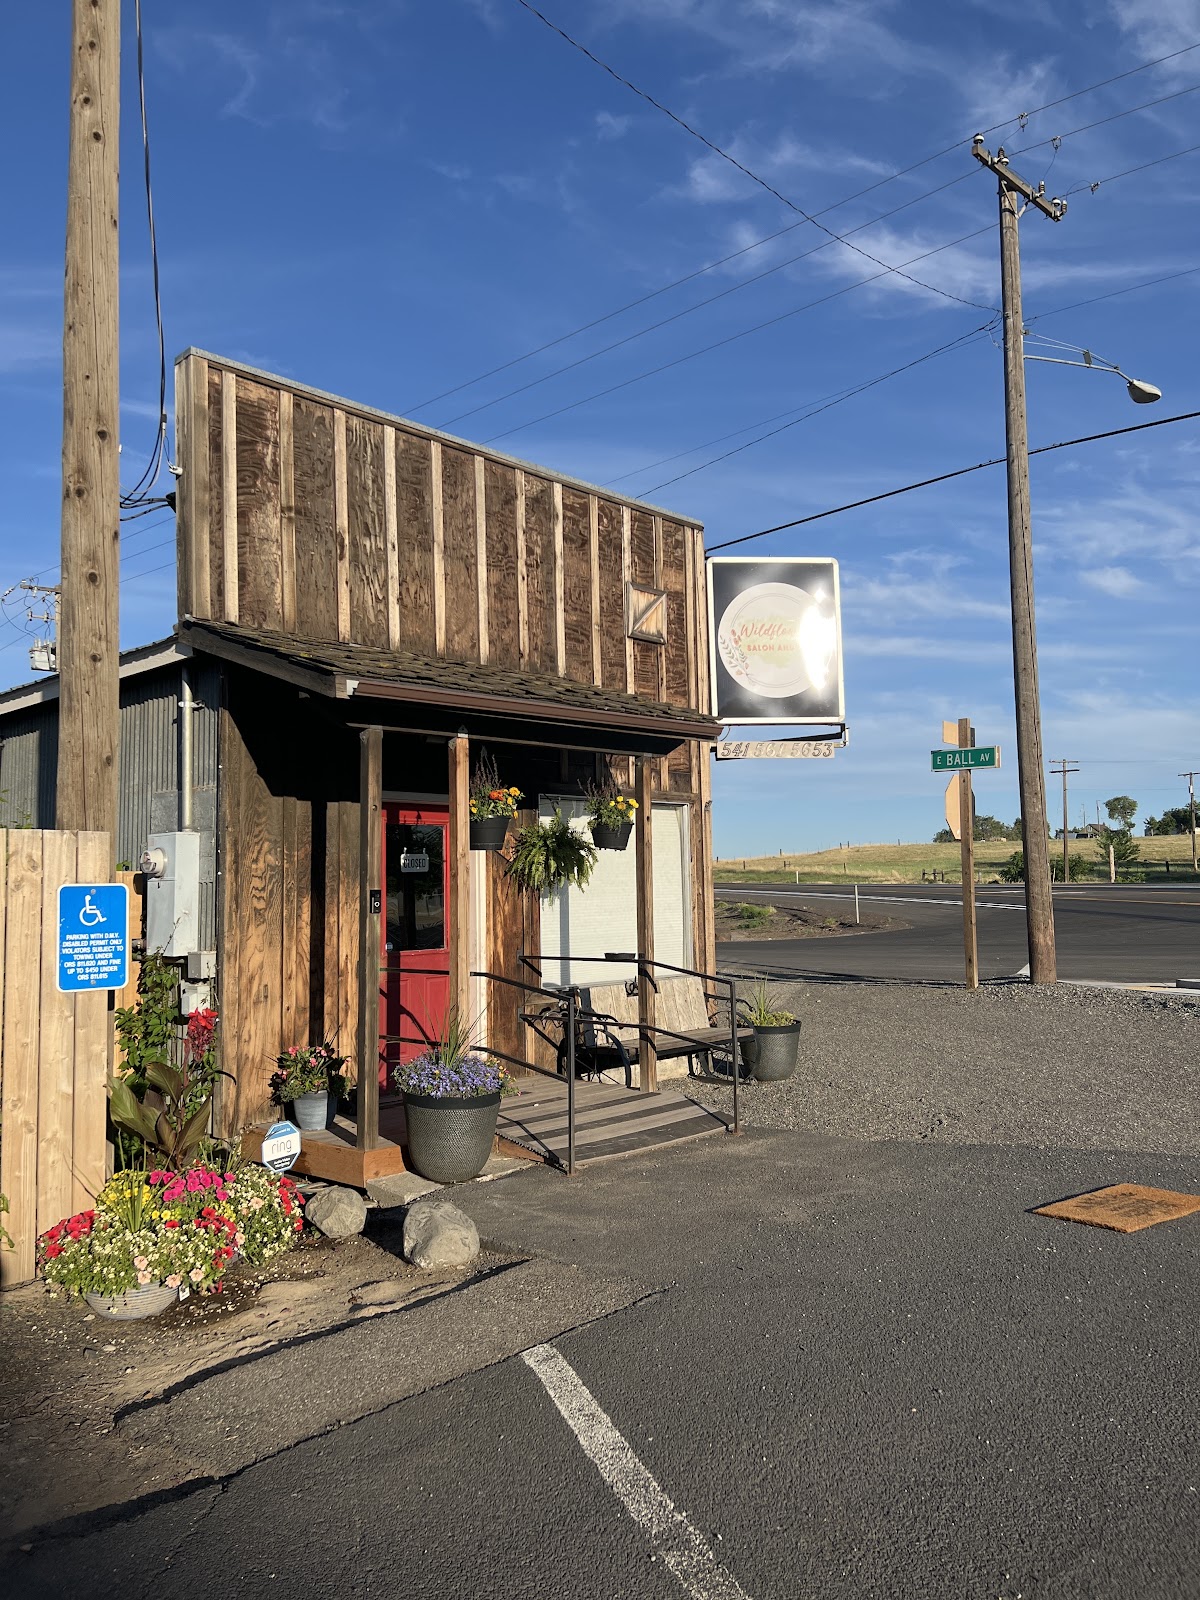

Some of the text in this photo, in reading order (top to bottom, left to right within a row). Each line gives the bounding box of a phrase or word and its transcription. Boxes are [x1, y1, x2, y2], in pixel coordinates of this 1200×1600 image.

[747, 644, 775, 652] SALON
[720, 742, 750, 757] 541
[790, 742, 833, 757] 5653
[936, 753, 991, 766] E BALL AV
[404, 858, 426, 868] CLOSED
[271, 1139, 292, 1155] ring
